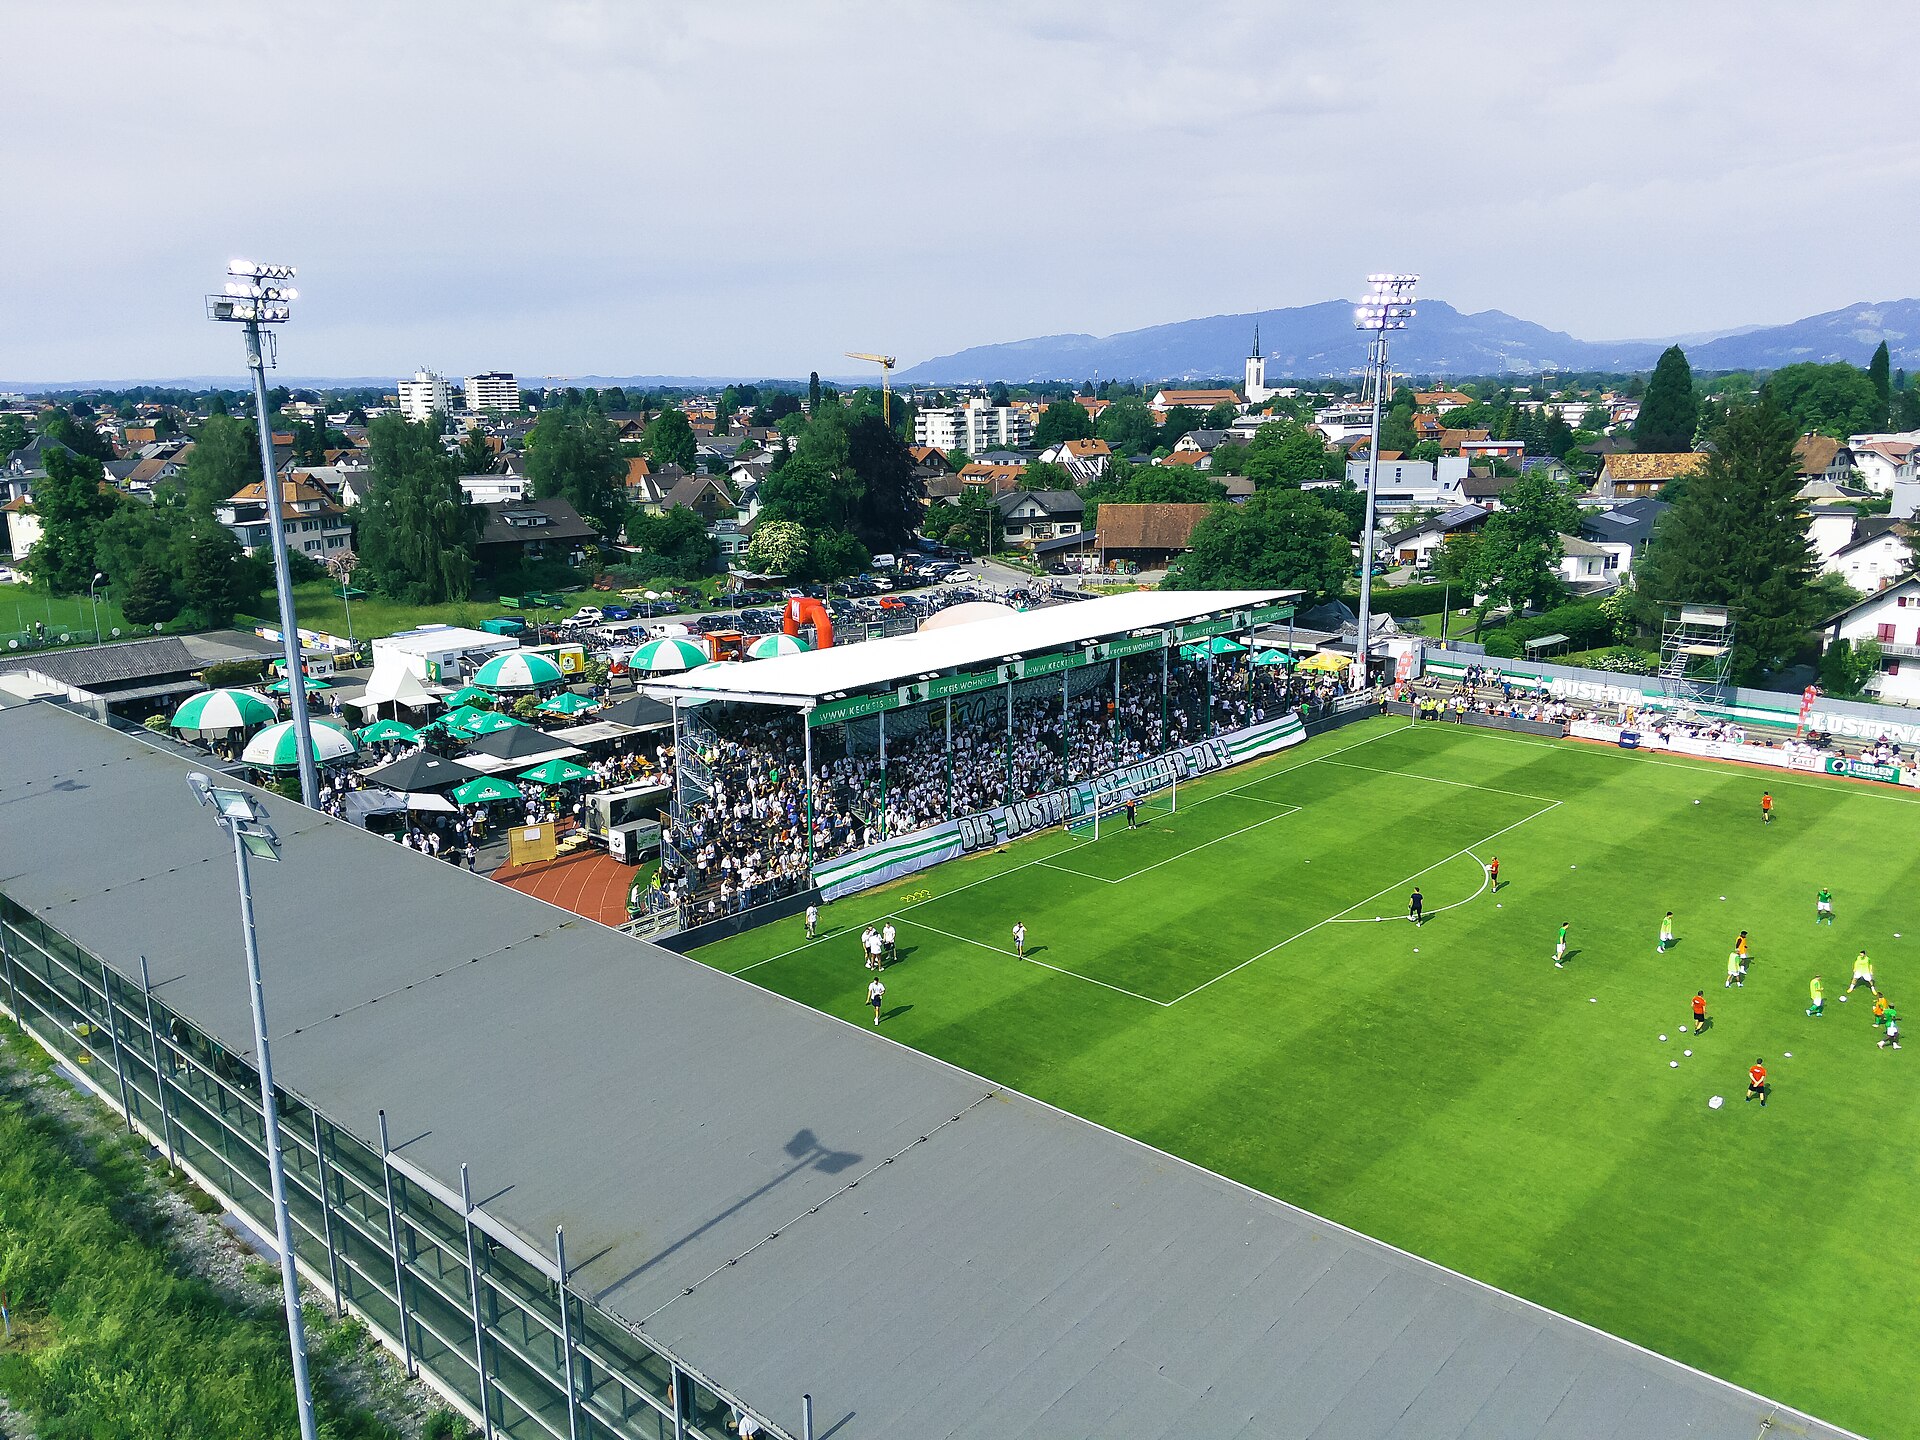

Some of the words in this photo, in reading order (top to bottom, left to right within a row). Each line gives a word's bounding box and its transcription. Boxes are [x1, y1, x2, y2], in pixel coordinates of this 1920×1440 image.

[1550, 677, 1644, 707] AUSTRIA
[958, 813, 997, 851] DIE
[1004, 787, 1085, 839] AUSTRIA
[1089, 773, 1121, 807] IST
[1126, 752, 1190, 796] WIEDER
